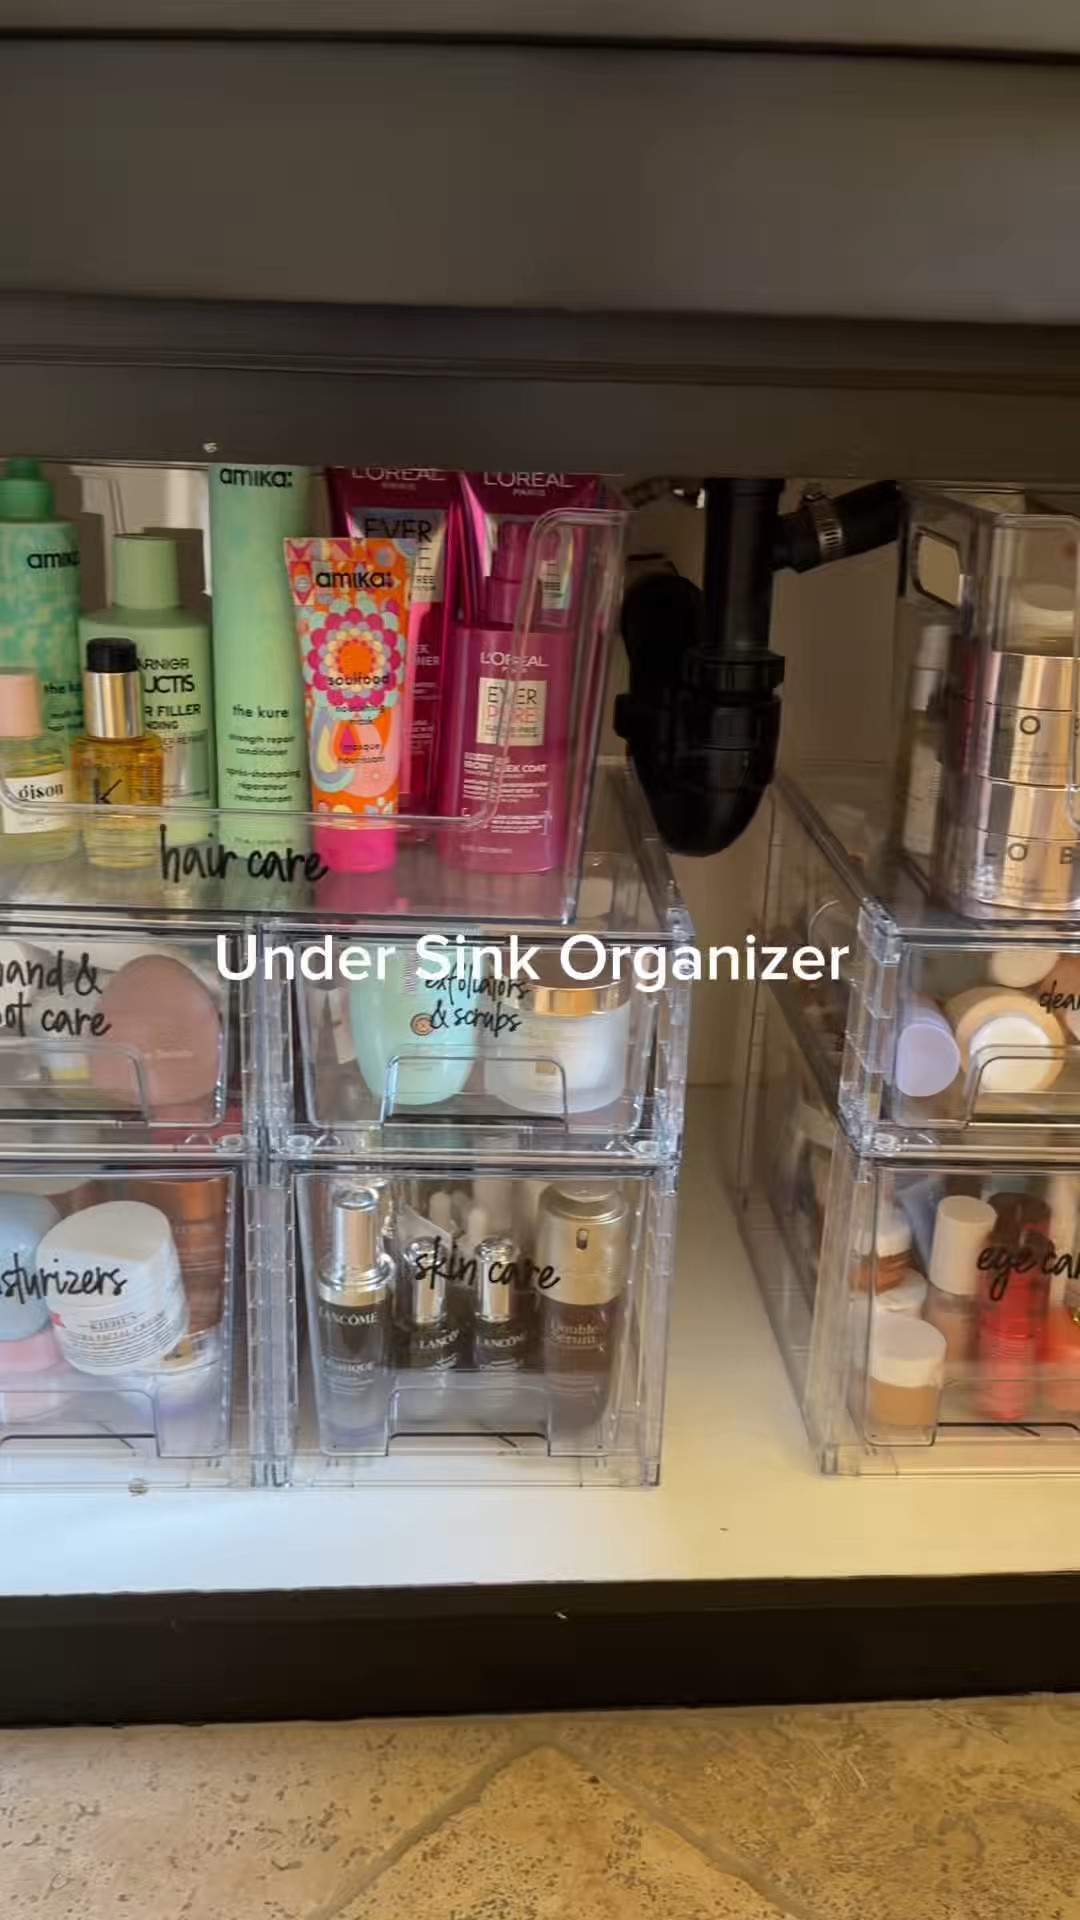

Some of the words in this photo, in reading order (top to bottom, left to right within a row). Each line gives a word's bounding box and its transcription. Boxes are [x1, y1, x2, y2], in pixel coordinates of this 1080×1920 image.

[351, 466, 448, 482] LOREAL
[483, 471, 577, 489] LOREAL
[315, 571, 393, 589] amika:
[138, 657, 190, 671] RNIER
[143, 674, 196, 694] UCTIS
[328, 674, 390, 687] soulfood
[157, 703, 202, 717] FILLER
[232, 704, 253, 718] the
[257, 705, 290, 718] kure
[487, 706, 538, 724] PRE
[160, 824, 238, 883] hair
[246, 847, 329, 883] care
[74, 952, 103, 996] &
[0, 991, 32, 1037] ot
[41, 1006, 112, 1037] care
[430, 999, 450, 1030] &
[453, 1001, 523, 1038] scrubs
[414, 1235, 477, 1290] skin
[488, 1257, 561, 1290] care
[976, 1245, 1038, 1302] eye
[1040, 1240, 1080, 1280] ca
[0, 1252, 128, 1305] sturizers
